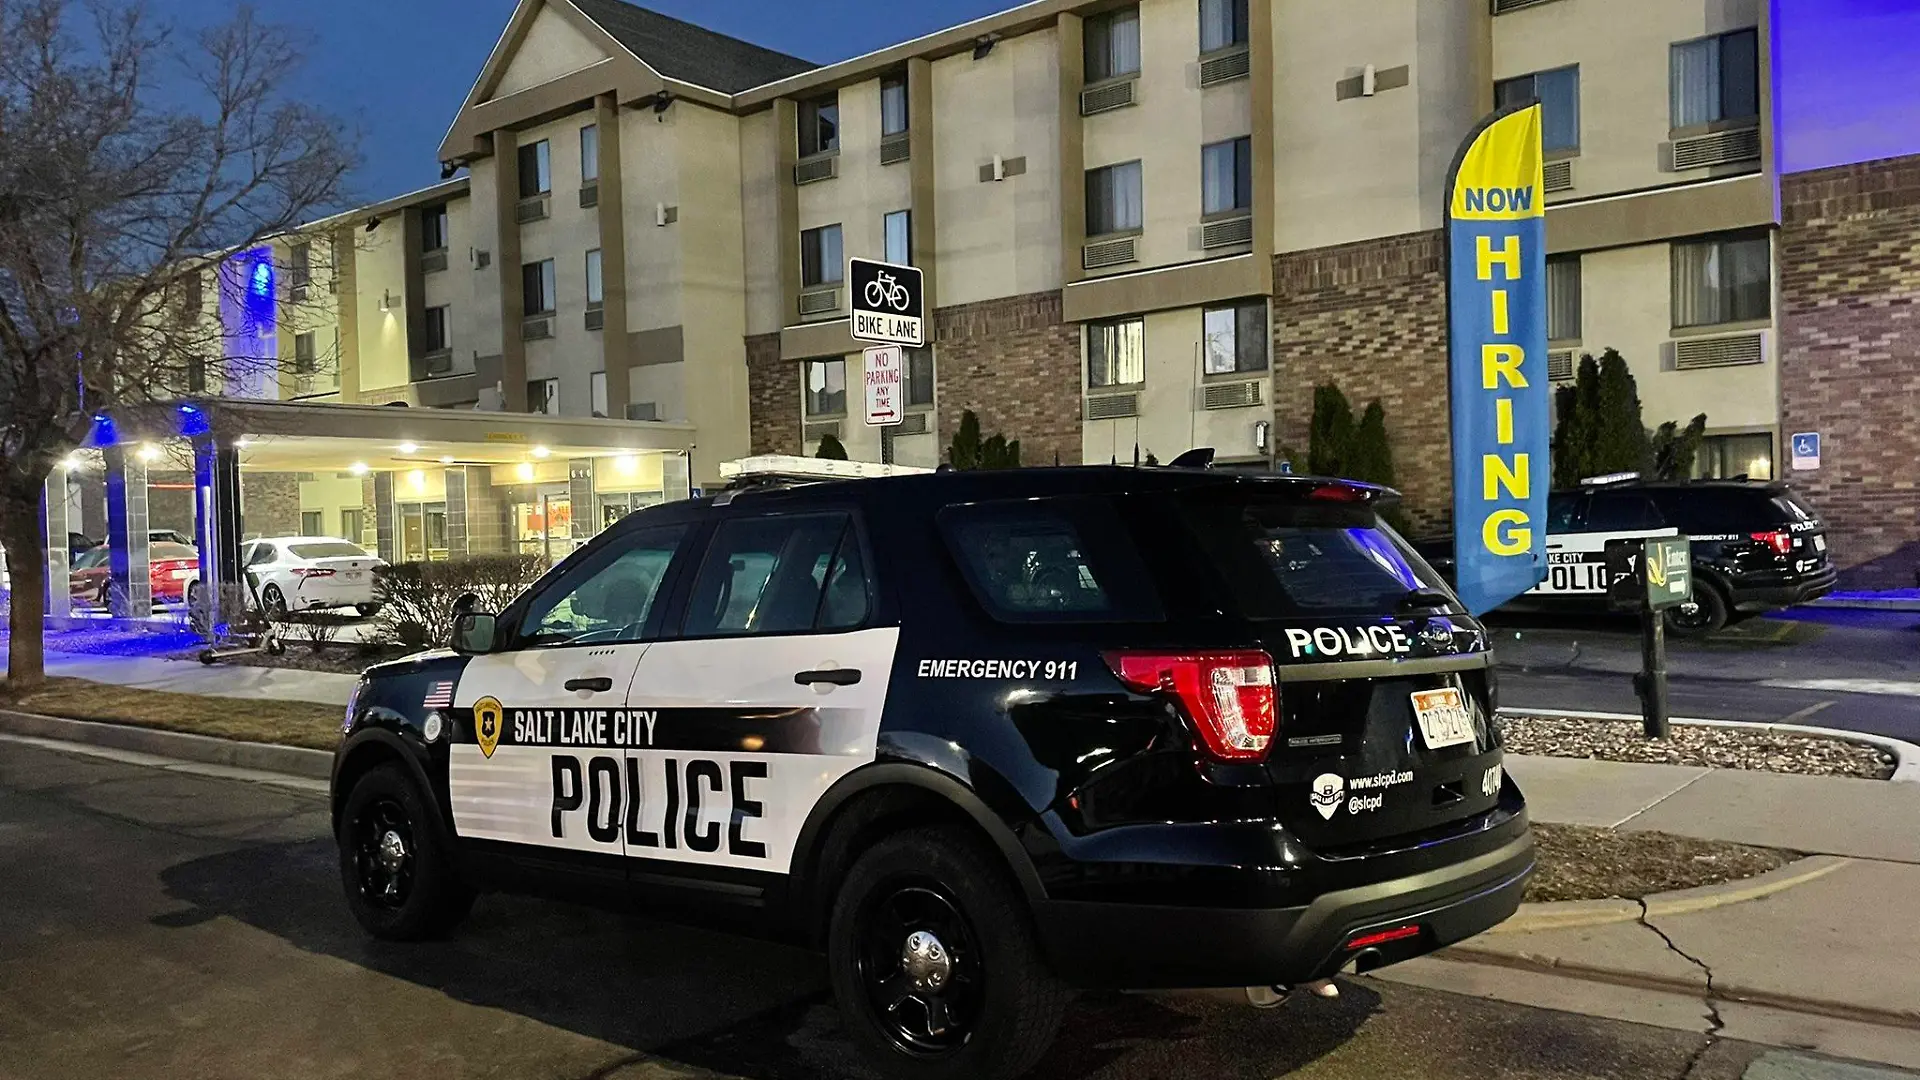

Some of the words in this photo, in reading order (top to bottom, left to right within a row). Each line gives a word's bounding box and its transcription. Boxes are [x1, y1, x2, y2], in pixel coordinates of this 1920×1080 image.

[1465, 186, 1533, 212] NOW
[858, 315, 884, 335] BIKE
[888, 319, 918, 339] LANE
[875, 353, 889, 367] NO
[866, 369, 899, 386] PARKING
[876, 386, 890, 397] ANY
[1475, 234, 1533, 557] HIRING
[876, 398, 891, 408] TIME
[1563, 552, 1584, 564] CITY
[1665, 546, 1688, 568] Enter
[1284, 625, 1411, 658] POLICE
[918, 660, 1041, 679] EMERGENCY
[1044, 661, 1078, 680] 911
[514, 711, 554, 743] SALT
[560, 711, 607, 744] LAKE
[614, 711, 658, 745] CITY
[1349, 769, 1414, 790] www.slcpd.com
[551, 754, 770, 859] POLICE
[1348, 792, 1383, 815] @slcpd
